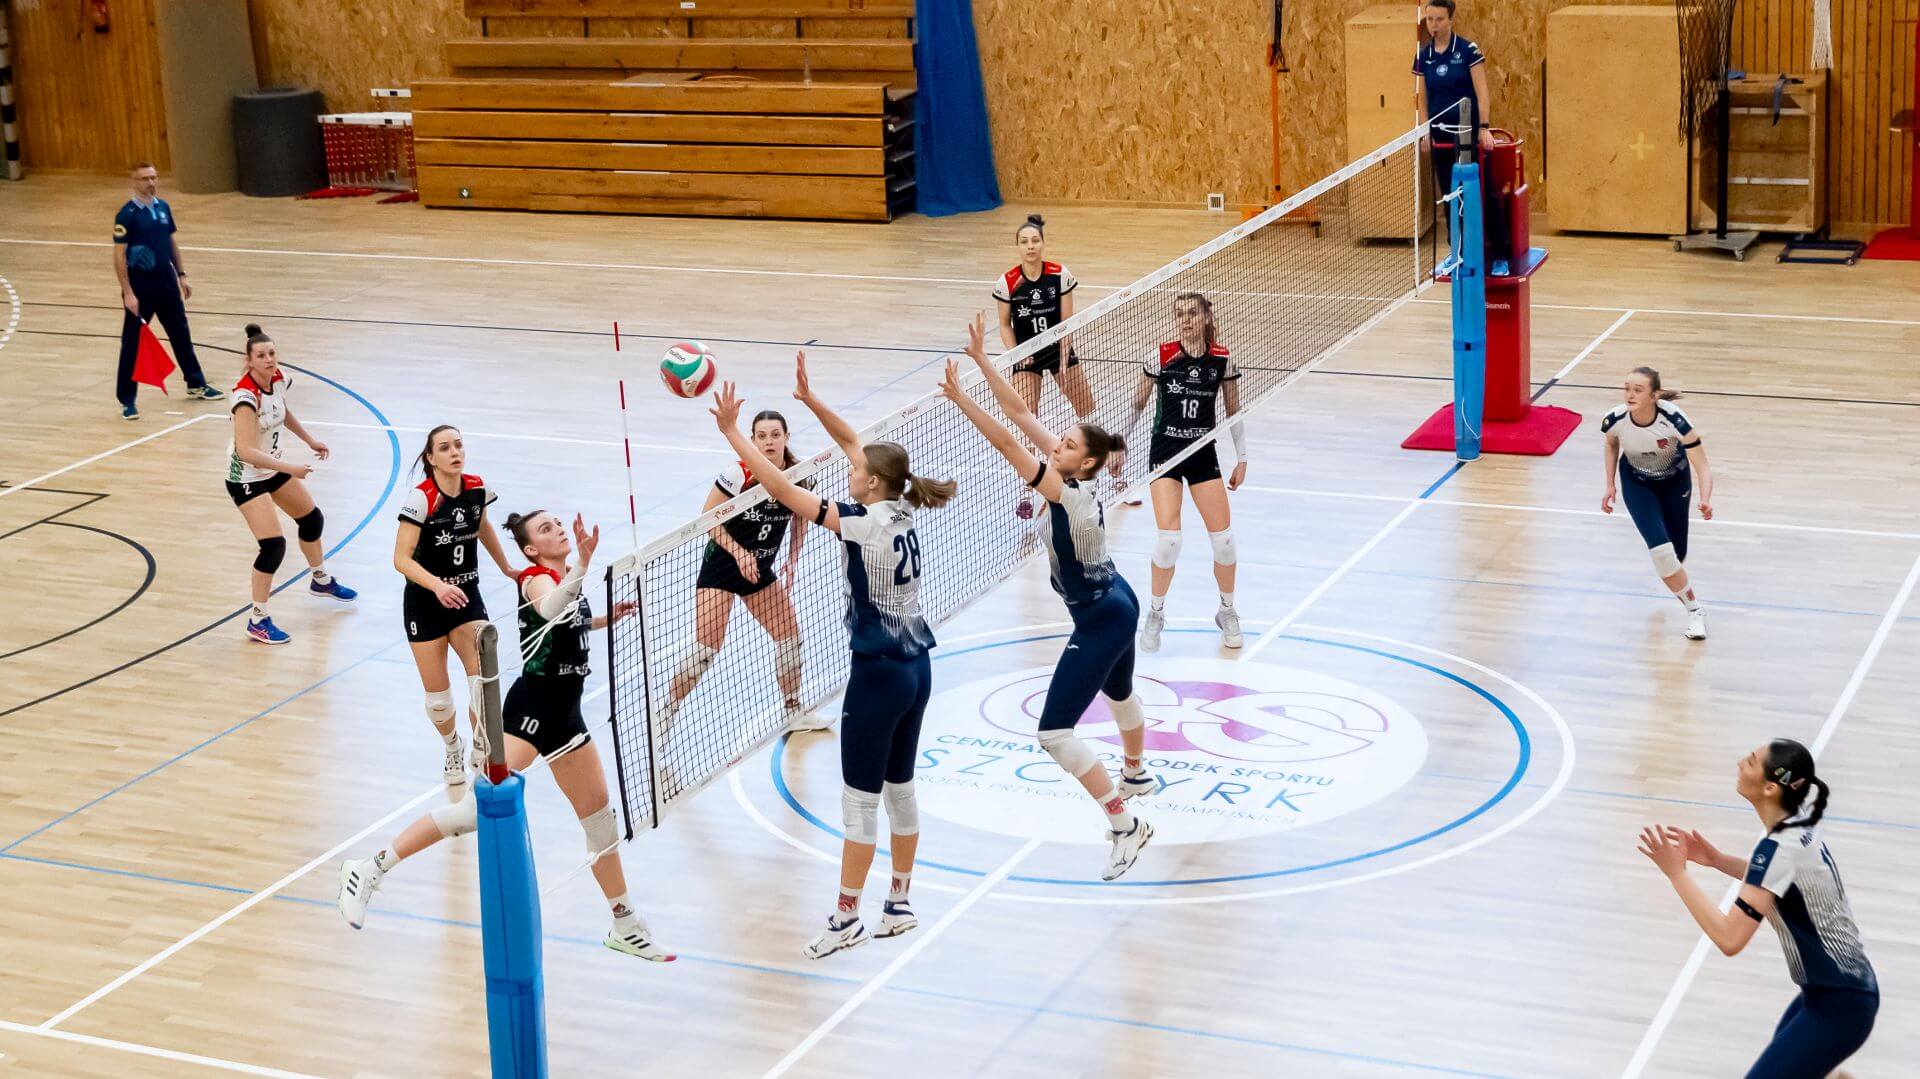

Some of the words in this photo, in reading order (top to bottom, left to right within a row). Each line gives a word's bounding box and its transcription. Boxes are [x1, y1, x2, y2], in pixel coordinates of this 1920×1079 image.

[1031, 316, 1048, 333] 19
[1180, 399, 1199, 418] 18
[271, 431, 280, 450] 2
[242, 483, 253, 495] 2
[757, 523, 772, 541] 8
[453, 544, 465, 566] 9
[893, 528, 921, 586] 28
[410, 621, 418, 635] 9
[519, 715, 540, 735] 10
[1230, 767, 1335, 786] SPORTU
